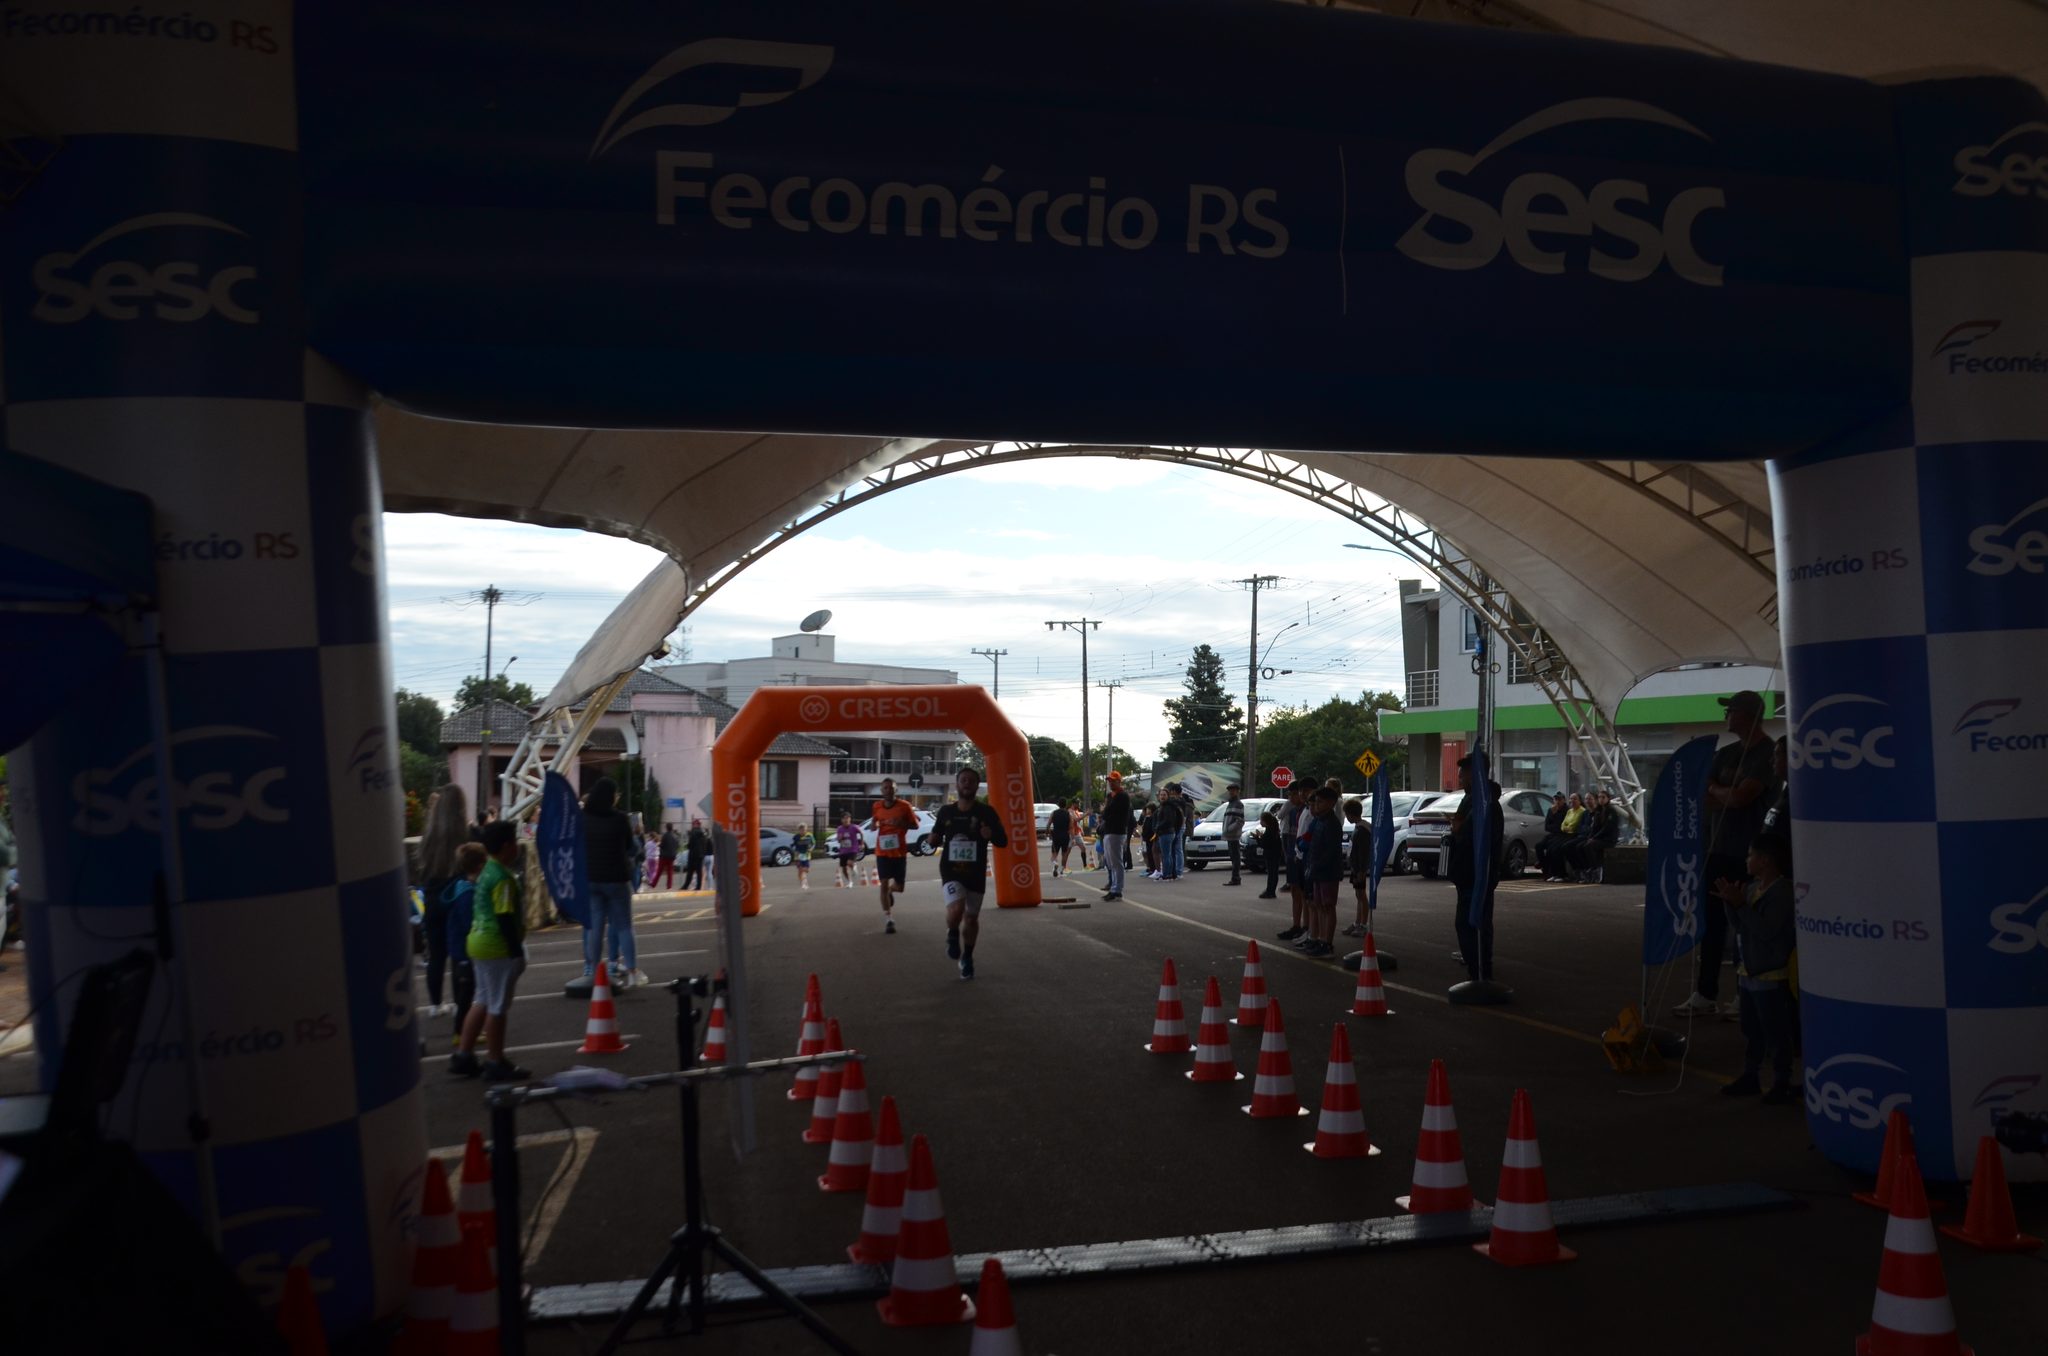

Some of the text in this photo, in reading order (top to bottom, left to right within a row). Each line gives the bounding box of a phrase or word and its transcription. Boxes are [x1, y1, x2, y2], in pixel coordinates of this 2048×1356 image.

[3, 5, 279, 54] Fecomércio RS
[654, 149, 1290, 259] Fecomércio RS
[1395, 147, 1726, 287] Sesc
[30, 250, 260, 325] Sesc
[254, 531, 299, 560] RS
[1871, 547, 1908, 571] RS
[839, 696, 948, 719] CRESOL
[1007, 766, 1028, 857] CRESOL
[1672, 760, 1684, 840] Fecomércio
[1687, 796, 1699, 840] Senac
[953, 849, 973, 860] 142
[1673, 853, 1699, 937] Sesc
[1892, 919, 1930, 942] RS
[294, 1013, 339, 1046] RS
